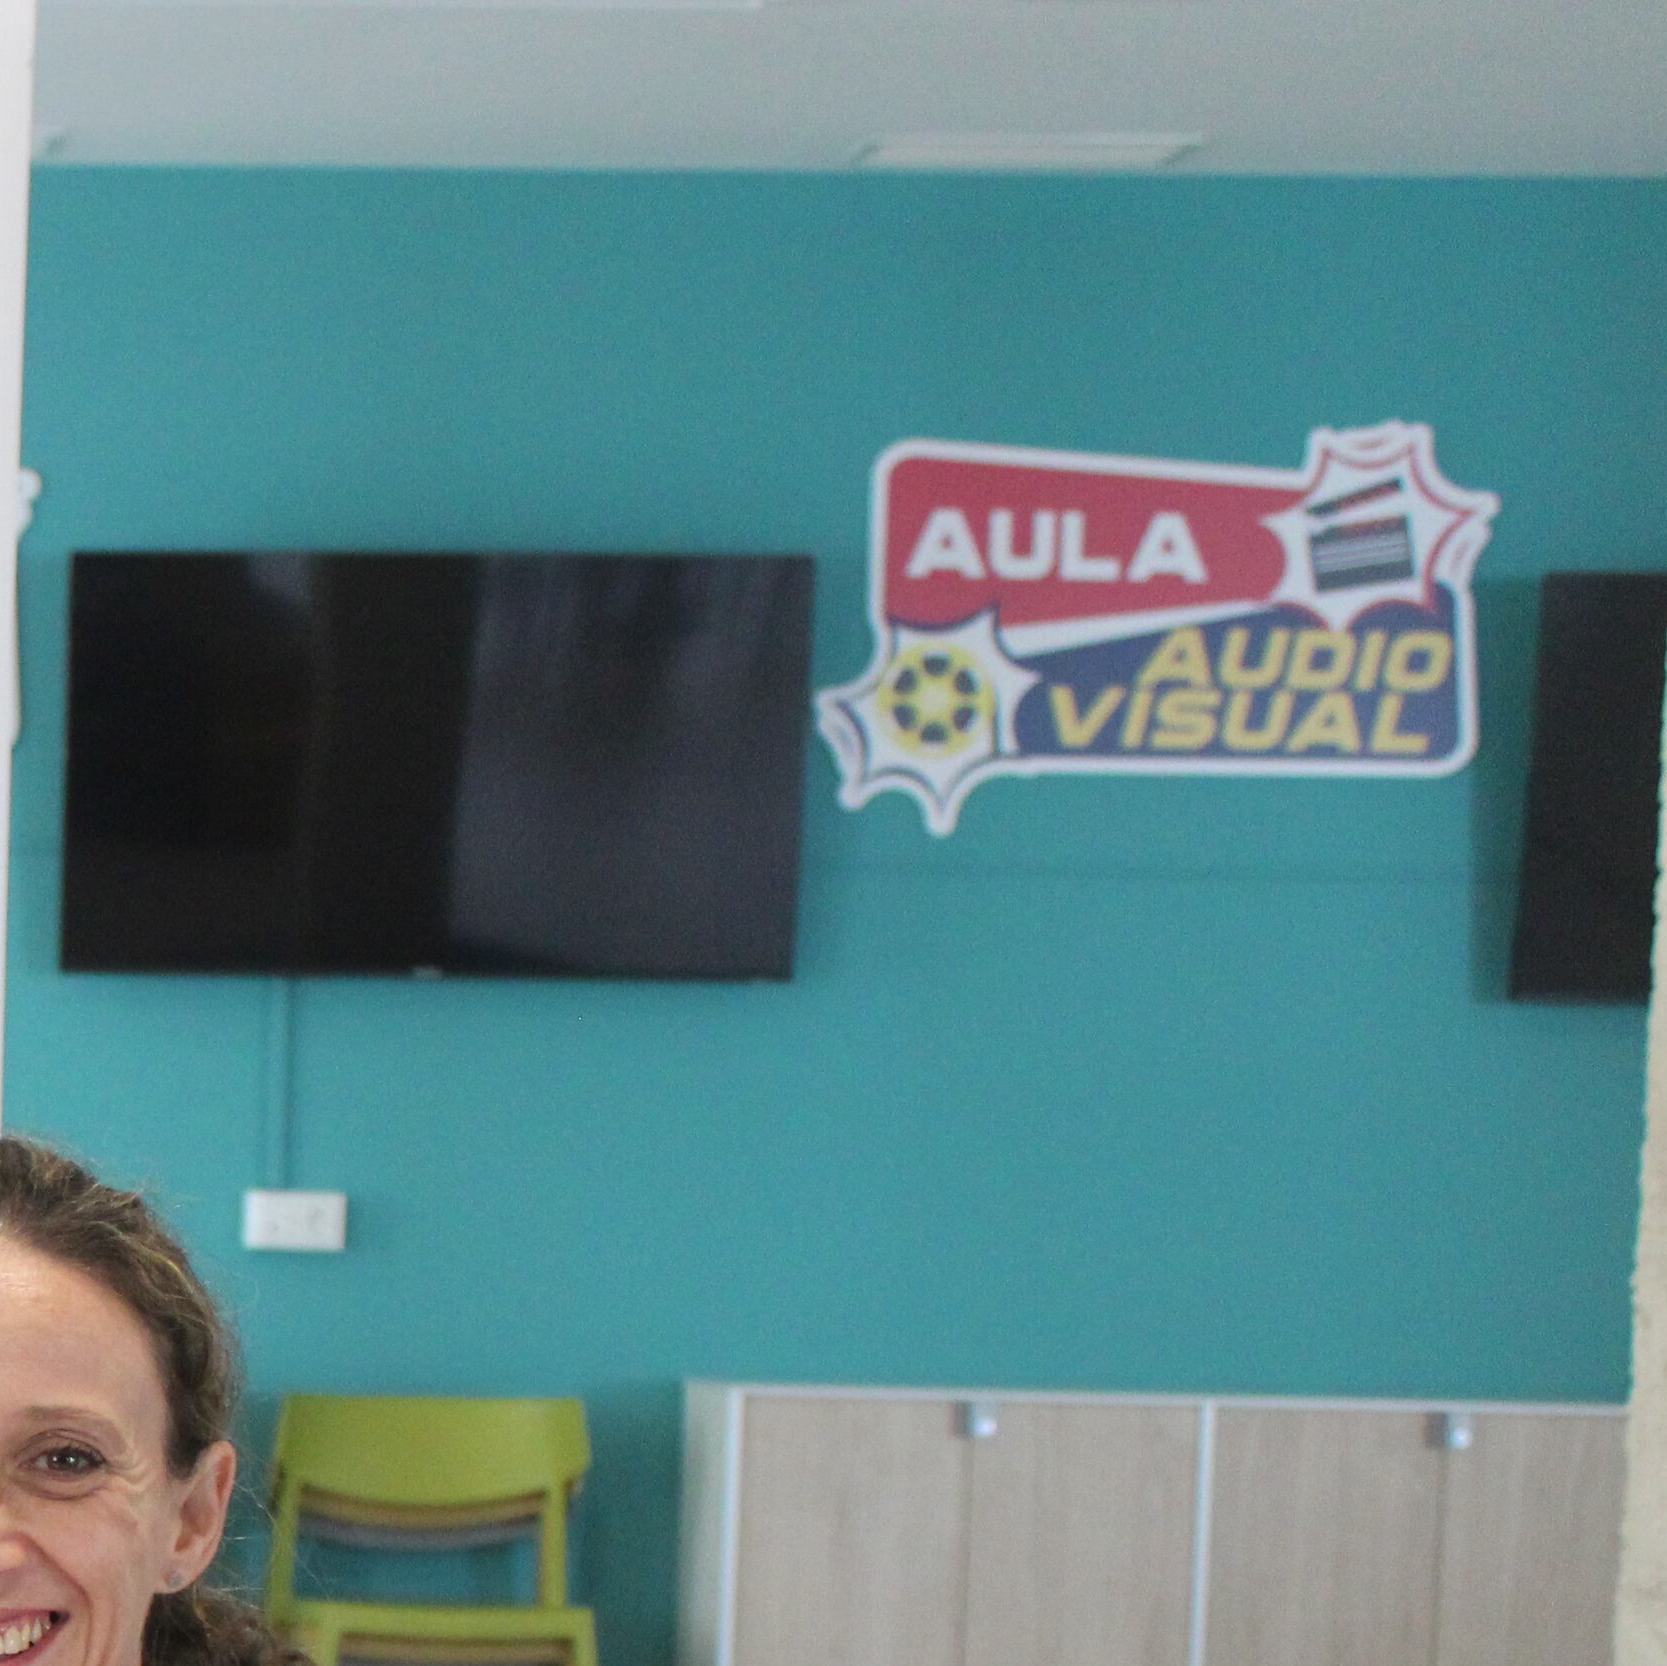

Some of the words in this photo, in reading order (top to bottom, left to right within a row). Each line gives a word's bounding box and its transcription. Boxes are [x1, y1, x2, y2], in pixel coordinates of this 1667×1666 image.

[905, 509, 1207, 583] AULA
[1136, 628, 1453, 692] AUDIO
[1048, 687, 1430, 753] VISUAL
